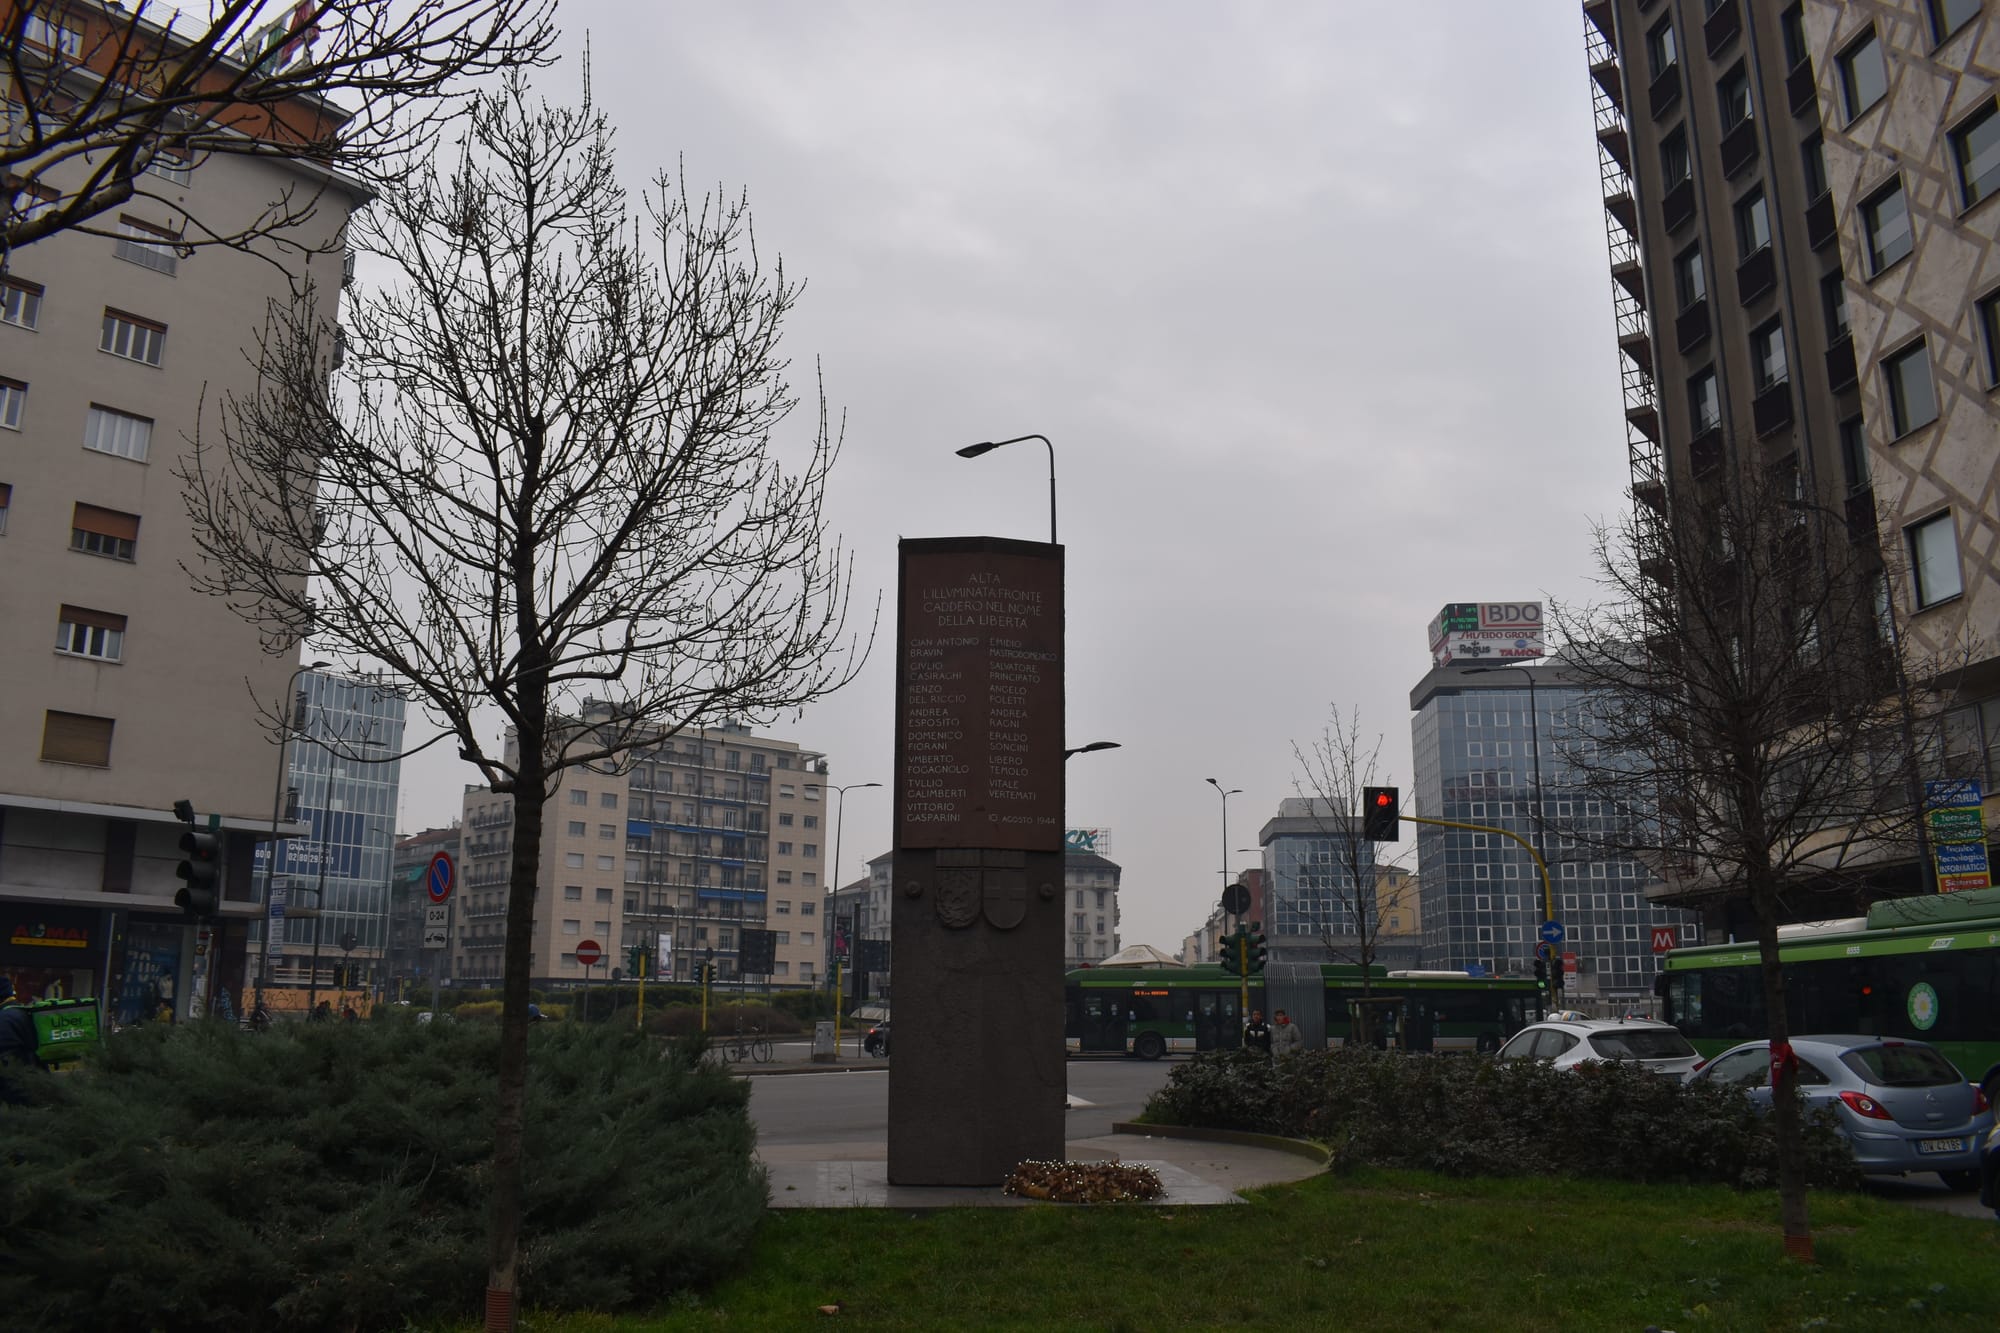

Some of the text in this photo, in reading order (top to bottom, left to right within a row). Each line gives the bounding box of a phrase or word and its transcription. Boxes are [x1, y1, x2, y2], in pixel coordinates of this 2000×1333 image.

[968, 573, 1000, 584] ALTA
[999, 589, 1041, 602] FRONTE
[923, 601, 1041, 616] CADDERO NEL NOME
[1488, 604, 1540, 622] BDO
[938, 616, 975, 626] DELLA
[1458, 631, 1537, 640] SHISEIDO GROUP
[937, 638, 979, 646] ANTONIO
[990, 638, 1022, 648] EMIDIO
[910, 649, 943, 657] BRAVIN
[1459, 644, 1490, 657] Regus
[1499, 648, 1544, 656] TAMOIL
[990, 662, 1038, 673] SALVATORE
[910, 672, 962, 681] CASIRAGHI
[990, 672, 1040, 684] PRINCIPATO
[910, 685, 942, 693] RENZO
[990, 684, 1027, 695] ANGELO
[910, 695, 966, 704] DEL RICCIO
[990, 696, 1025, 705] POLETTI
[910, 708, 949, 716] ANDREA
[990, 709, 1028, 719] ANDREA
[909, 718, 959, 727] ESPOSITO
[908, 731, 963, 740] DOMENICO
[990, 733, 1028, 742] ERALDO
[908, 742, 947, 751] FIORANI
[990, 743, 1029, 752] SONCINI
[908, 755, 953, 764] VMBERTO
[989, 756, 1023, 765] LIBERO
[908, 765, 969, 774] FOGAGNOLO
[990, 766, 1029, 776] TEMOLO
[907, 779, 943, 787] TVLLIO
[989, 780, 1019, 789] VITALE
[907, 789, 966, 799] GALIMBERTI
[989, 791, 1036, 800] VERTEMATI
[907, 803, 954, 811] VITTORIO
[907, 813, 960, 822] GASPARINI
[1037, 817, 1055, 825] 1944
[288, 843, 304, 851] GVA
[1938, 853, 1984, 863] Tecnologico
[1939, 863, 1986, 873] INFORMATICO
[430, 911, 445, 921] 0-24
[1653, 932, 1673, 948] M
[50, 1015, 82, 1028] Uber
[51, 1027, 84, 1040] Eats
